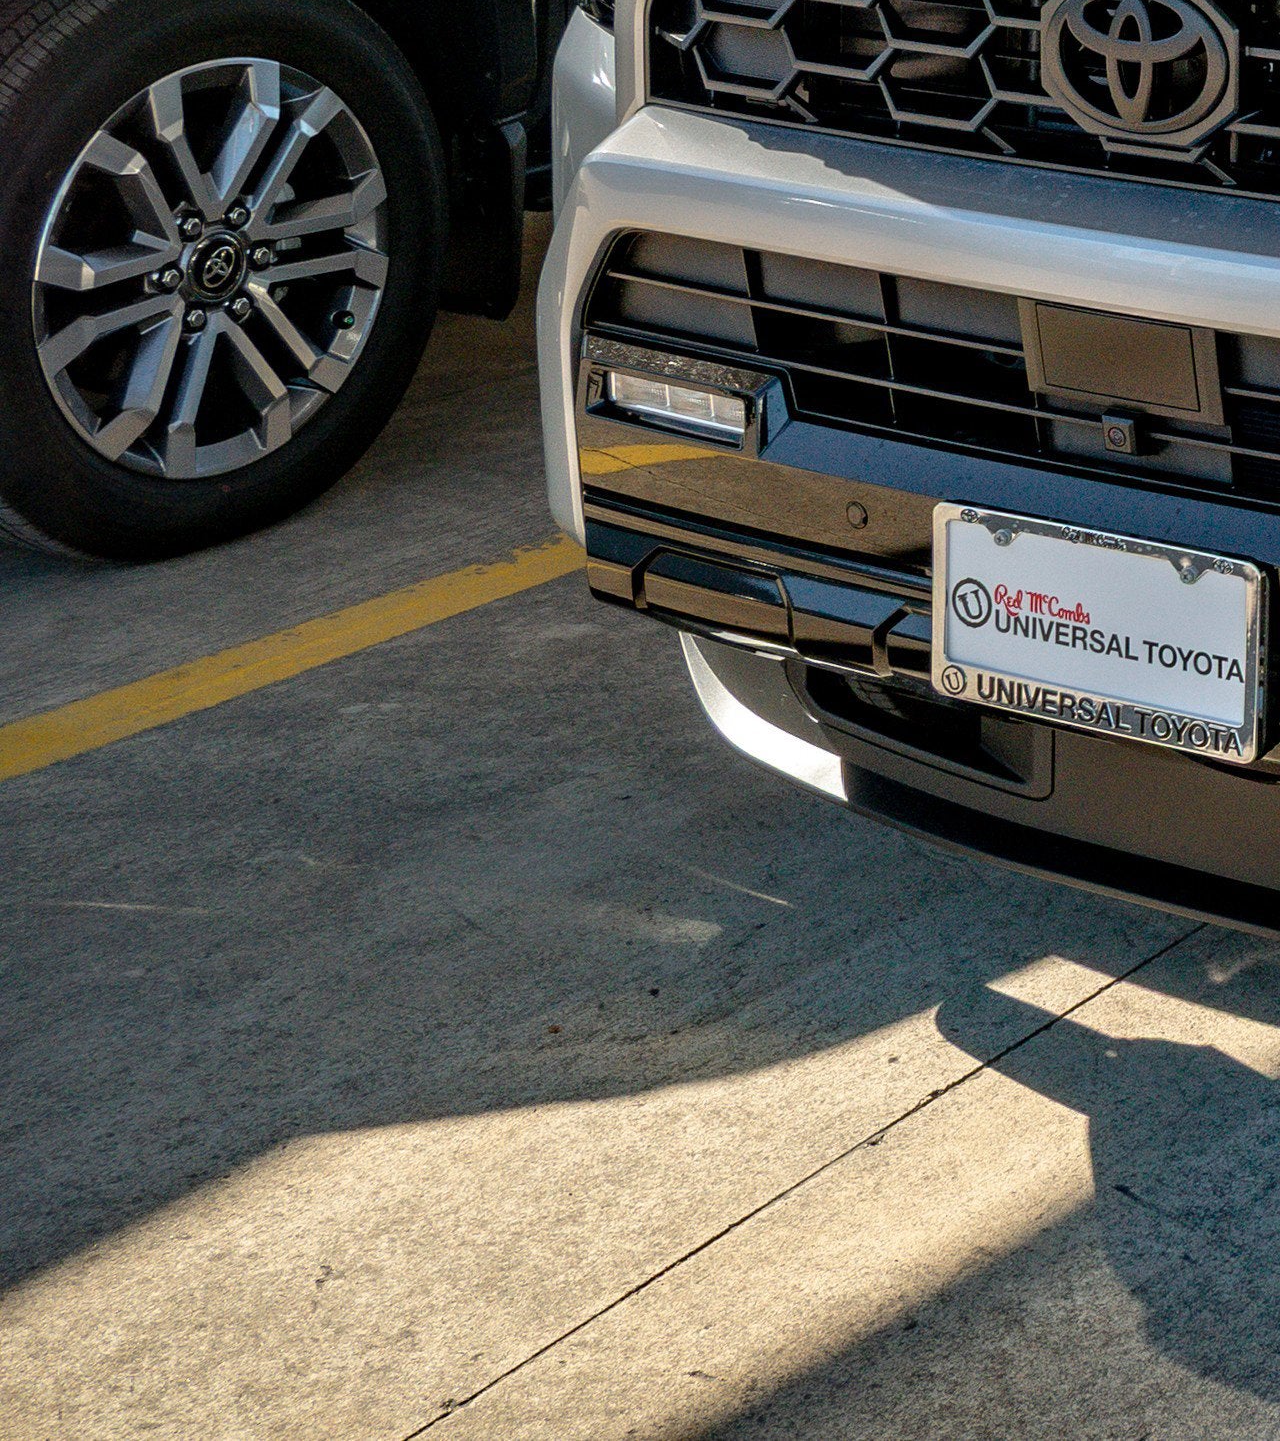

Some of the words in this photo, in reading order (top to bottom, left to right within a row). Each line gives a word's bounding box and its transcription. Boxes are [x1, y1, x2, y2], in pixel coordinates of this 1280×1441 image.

[994, 583, 1023, 617] Red
[1025, 589, 1091, 625] McCombs
[994, 608, 1140, 662] UNIVERSAL
[1142, 639, 1246, 684] TOYOTA
[976, 672, 1133, 731] UNIVERSAL
[1134, 707, 1244, 757] TOYOTA
